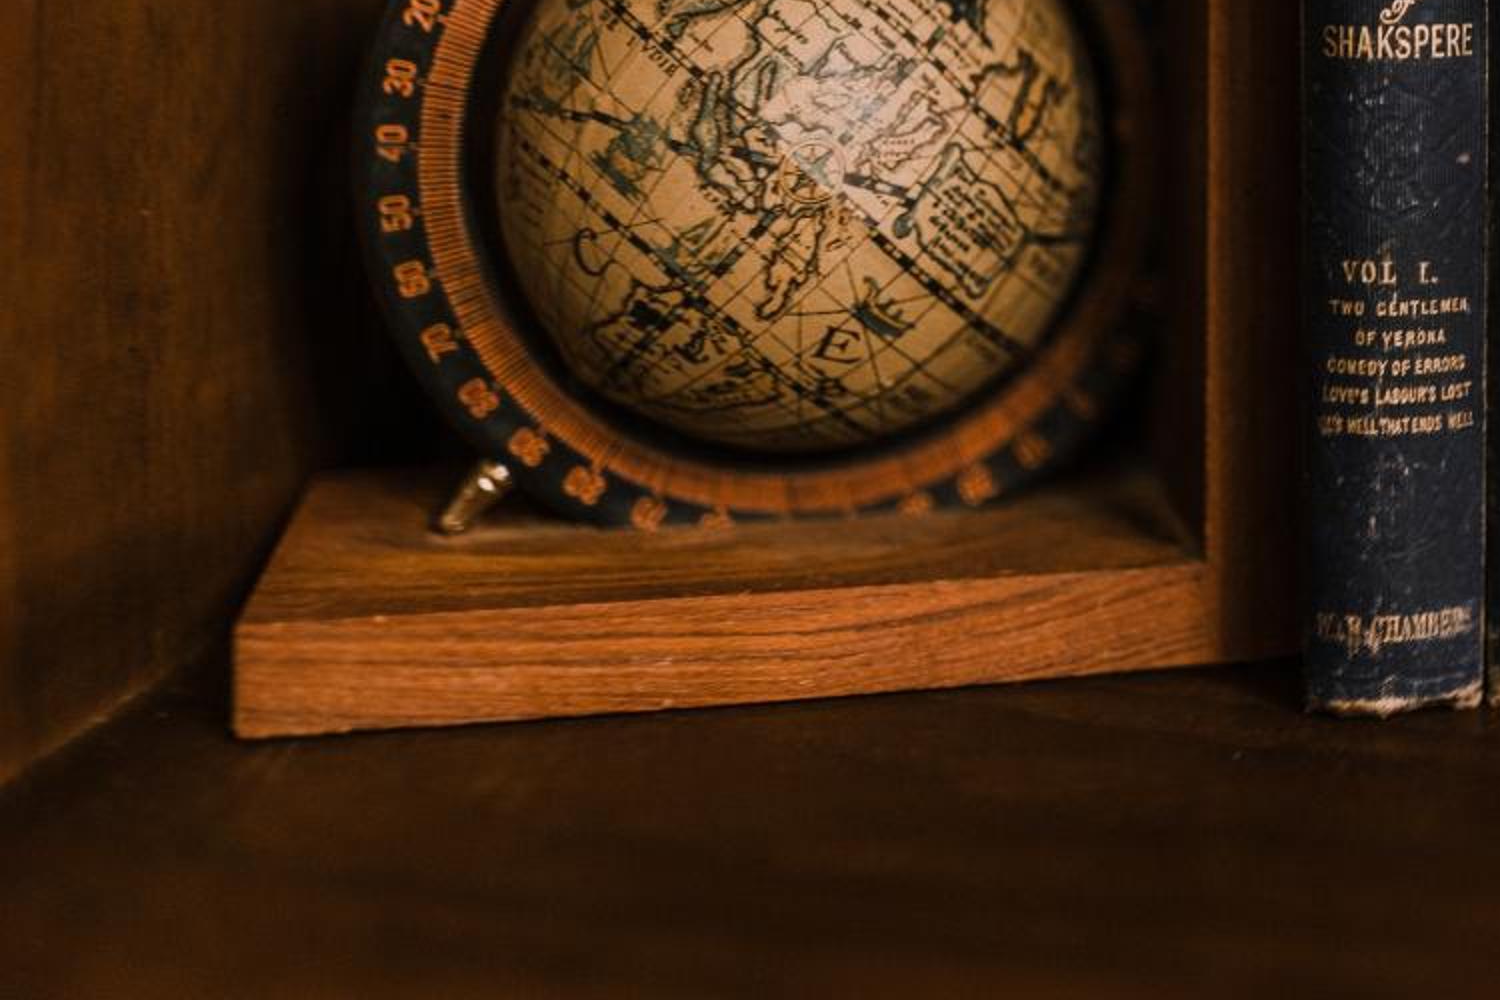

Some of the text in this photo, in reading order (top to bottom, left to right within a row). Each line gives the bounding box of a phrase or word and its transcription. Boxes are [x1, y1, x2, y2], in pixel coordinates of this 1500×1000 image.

[1321, 23, 1473, 60] SHAKSPERE
[383, 56, 417, 98] 30
[374, 122, 410, 163] 40
[376, 193, 414, 232] 50
[1328, 299, 1365, 317] TWO
[1391, 358, 1411, 376] OF
[1441, 381, 1472, 400] LOST
